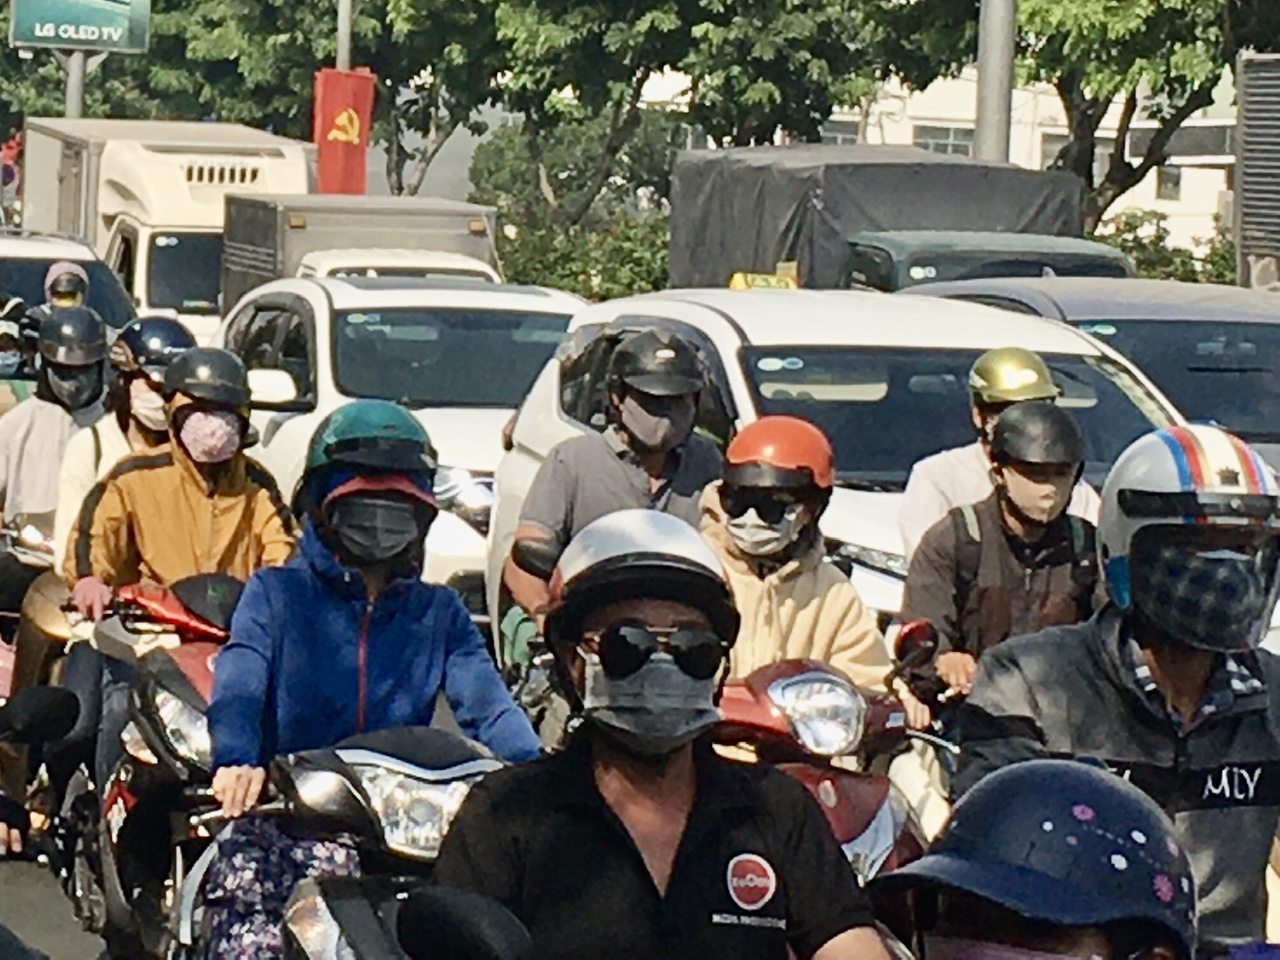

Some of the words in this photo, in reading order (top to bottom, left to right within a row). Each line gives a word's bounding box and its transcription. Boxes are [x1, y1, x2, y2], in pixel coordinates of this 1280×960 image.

[34, 23, 56, 38] LG
[58, 24, 100, 40] OLED
[101, 26, 123, 41] TV
[1202, 766, 1262, 800] MLY
